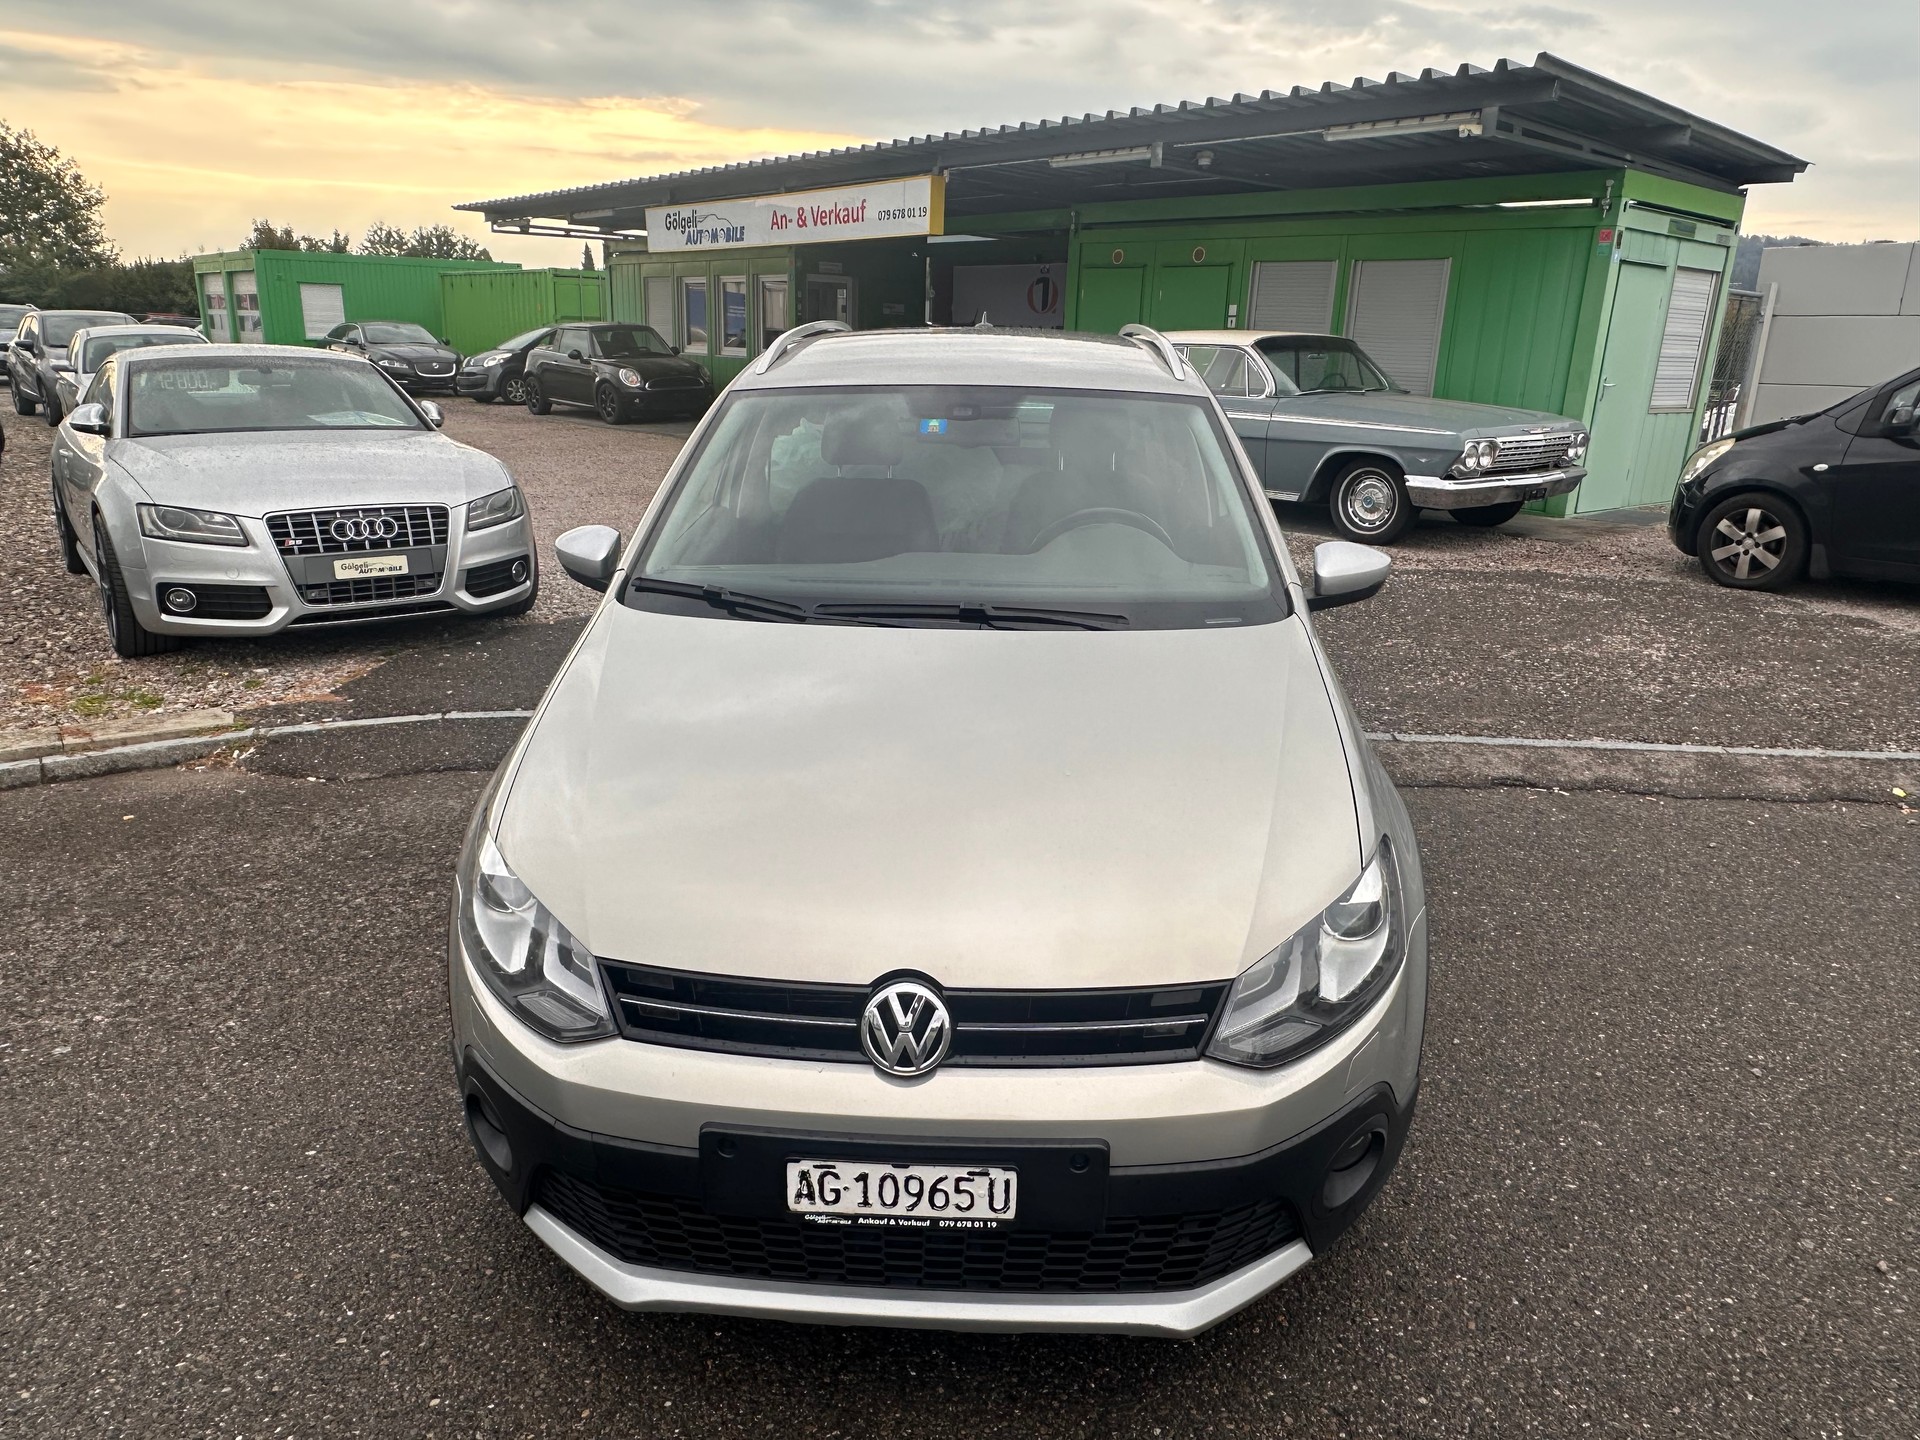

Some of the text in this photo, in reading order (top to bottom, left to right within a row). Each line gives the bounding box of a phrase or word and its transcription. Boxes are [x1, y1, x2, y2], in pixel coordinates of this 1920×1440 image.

[665, 210, 697, 234] Gölgeli
[797, 206, 808, 228] &
[811, 199, 866, 227] Verkauf
[877, 209, 891, 221] 079
[892, 208, 906, 220] 678
[907, 207, 917, 218] 01
[918, 206, 928, 217] 19
[685, 226, 745, 245] AUTOMOBILE
[857, 1217, 888, 1225] Ankauf
[898, 1219, 931, 1227] Verkauf
[939, 1220, 955, 1228] 079
